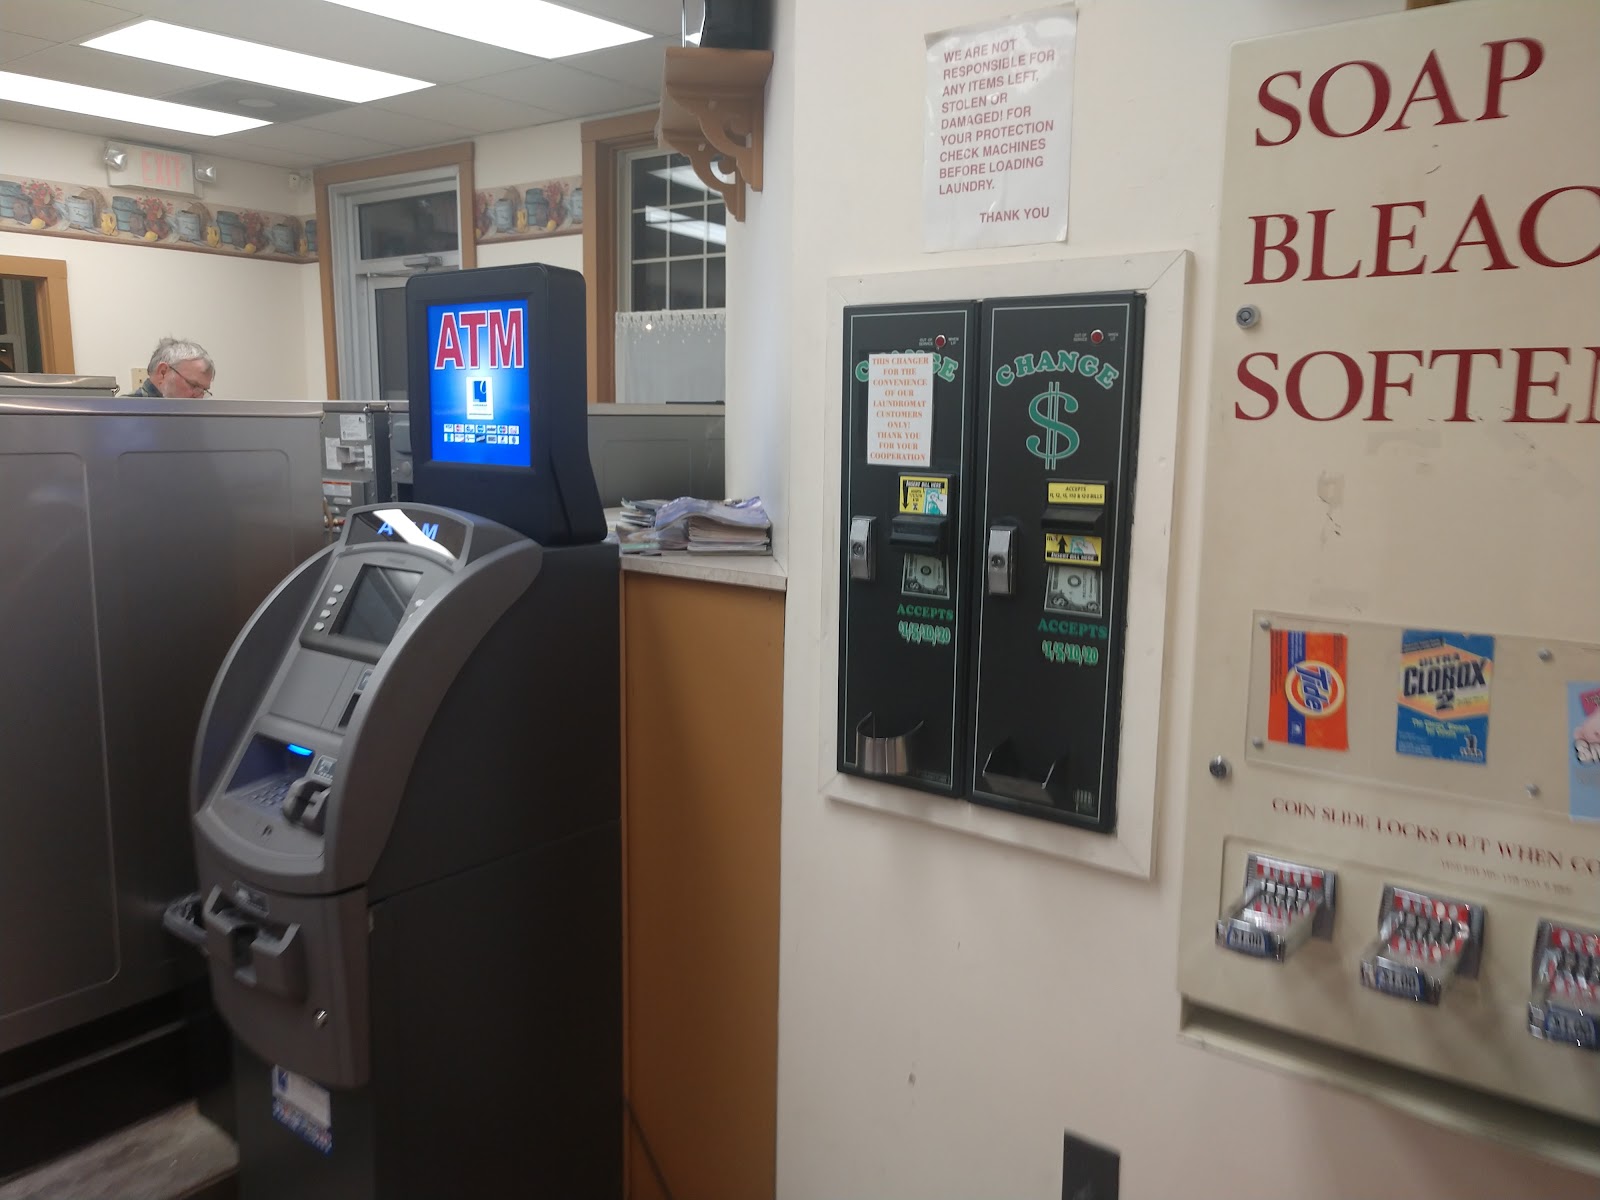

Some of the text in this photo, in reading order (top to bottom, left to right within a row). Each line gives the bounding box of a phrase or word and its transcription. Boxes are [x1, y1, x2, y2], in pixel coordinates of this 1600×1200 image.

[944, 38, 1017, 63] WE ARE NOT
[943, 49, 1056, 80] RESPONSIBLE FOR
[942, 69, 1040, 97] ANY ITEMS LEFT,
[1256, 37, 1545, 146] SOAP
[941, 92, 1008, 113] STOLEN OR
[941, 105, 1032, 130] DAMAGED! FOR
[940, 119, 1054, 146] YOUR PROTECTION
[939, 138, 1047, 163] CHECK MACHINES
[141, 150, 181, 189] EXIT
[939, 155, 1044, 179] BEFORE LOADING
[939, 179, 996, 195] LAUNDRY.
[979, 206, 1050, 223] THANK YOU
[434, 307, 525, 370] ATM
[872, 357, 929, 365] THIS CHANGER
[883, 368, 917, 376] FOR THE
[996, 350, 1119, 390] CHANGE
[873, 378, 928, 386] CONVENIENCE
[884, 389, 914, 397] OF OUR
[1234, 346, 1600, 424] SOFTE
[873, 400, 927, 408] LAUNDROMAT
[877, 431, 921, 440] THANK YOU
[879, 442, 918, 450] FOR YOUR
[870, 452, 926, 461] COOPERATION
[377, 521, 440, 541] AM
[897, 603, 954, 621] ACCEPTS
[1037, 617, 1109, 639] ACCEPTS
[1294, 663, 1332, 713] Tide
[1272, 797, 1317, 820] COIN
[1321, 806, 1370, 831] SLIDE
[1376, 815, 1441, 844] LOCKS
[1446, 830, 1491, 855] OUT
[1498, 840, 1564, 870] WHEN
